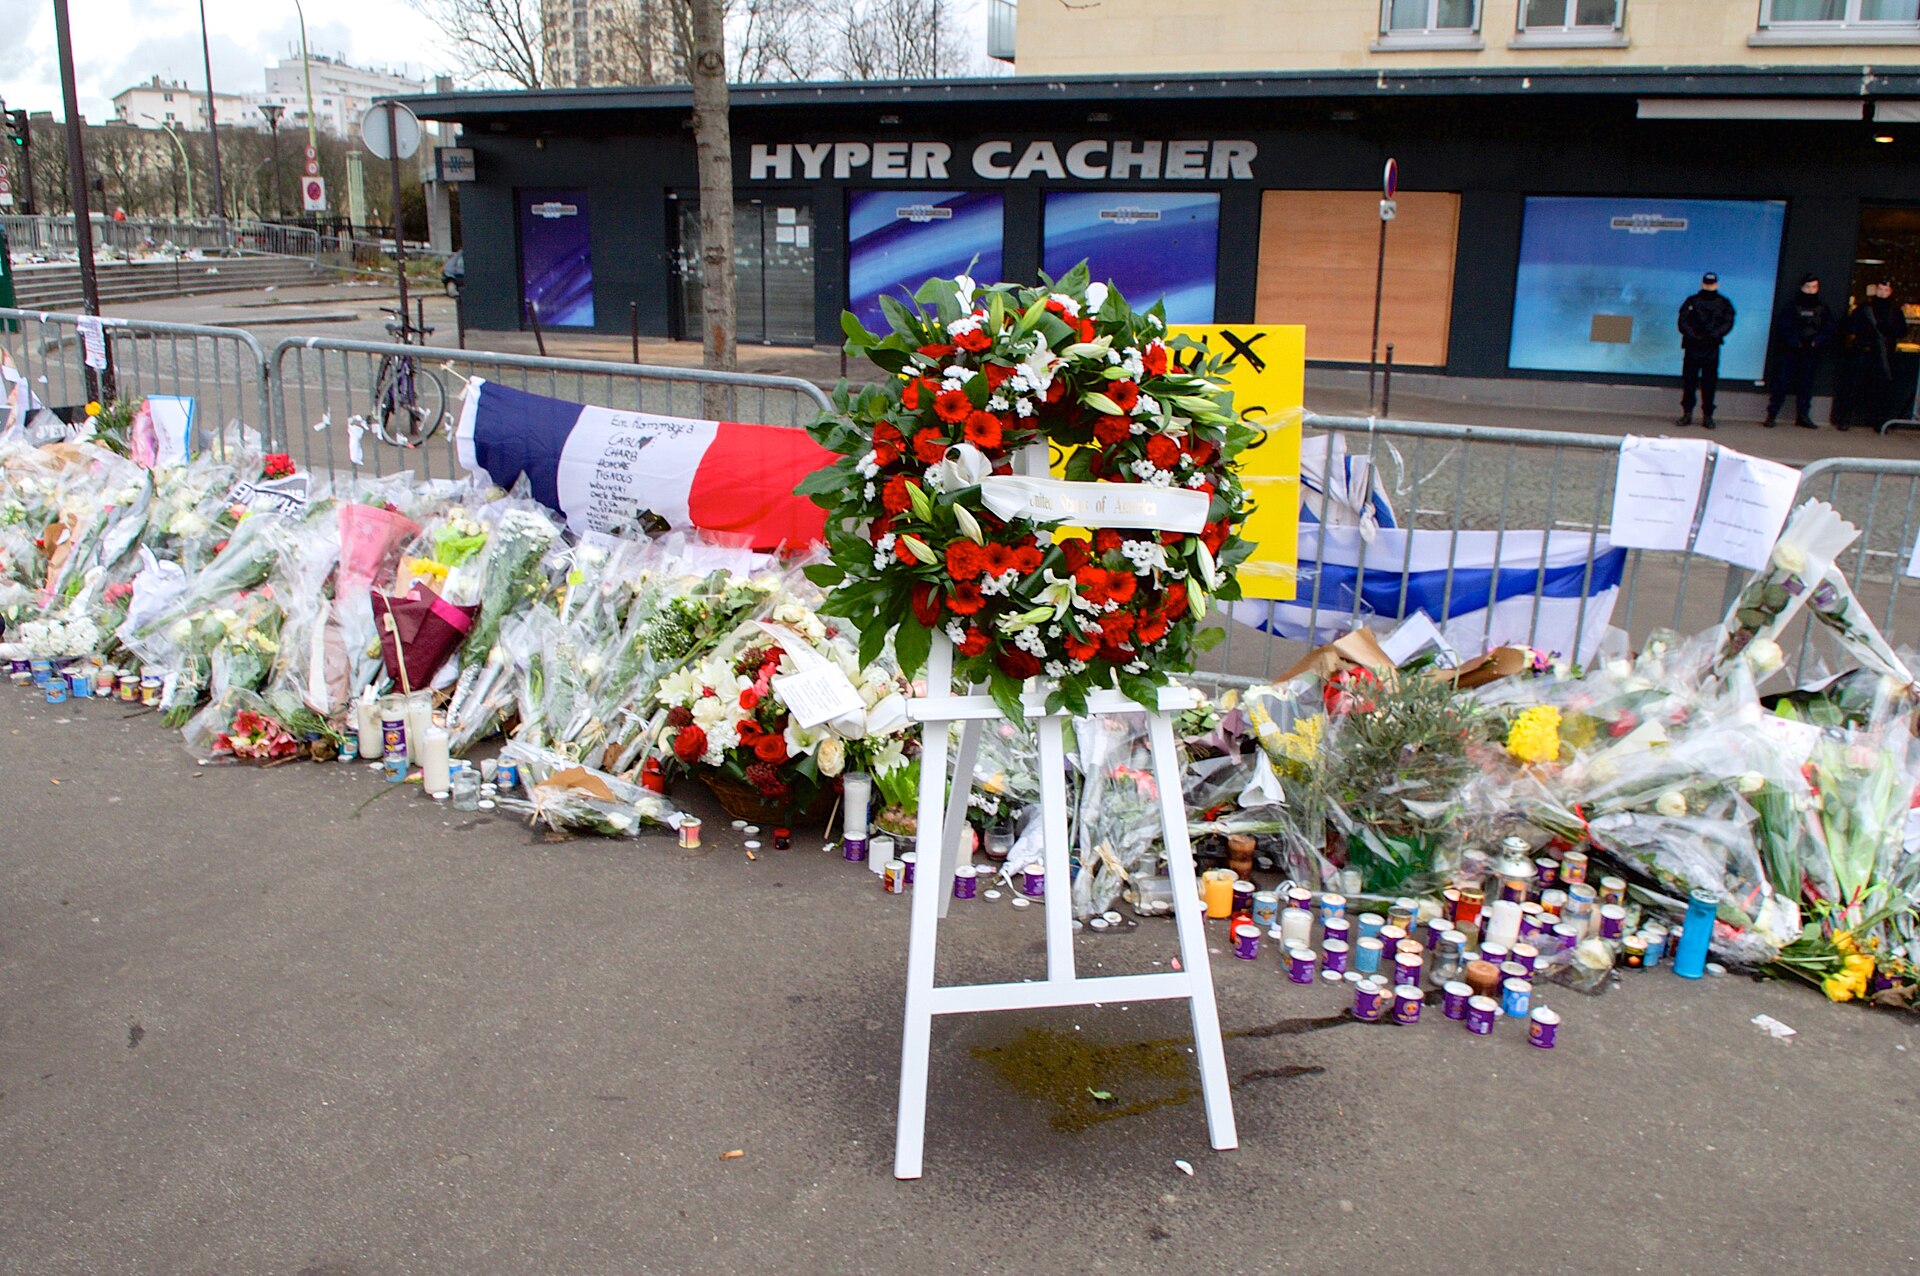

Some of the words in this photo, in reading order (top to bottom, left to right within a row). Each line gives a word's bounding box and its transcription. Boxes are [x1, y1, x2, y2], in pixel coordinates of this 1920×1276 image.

[750, 142, 952, 179] HYPER
[971, 140, 1258, 180] CACHER
[595, 469, 633, 484] TIGNOUS
[1094, 495, 1107, 513] of
